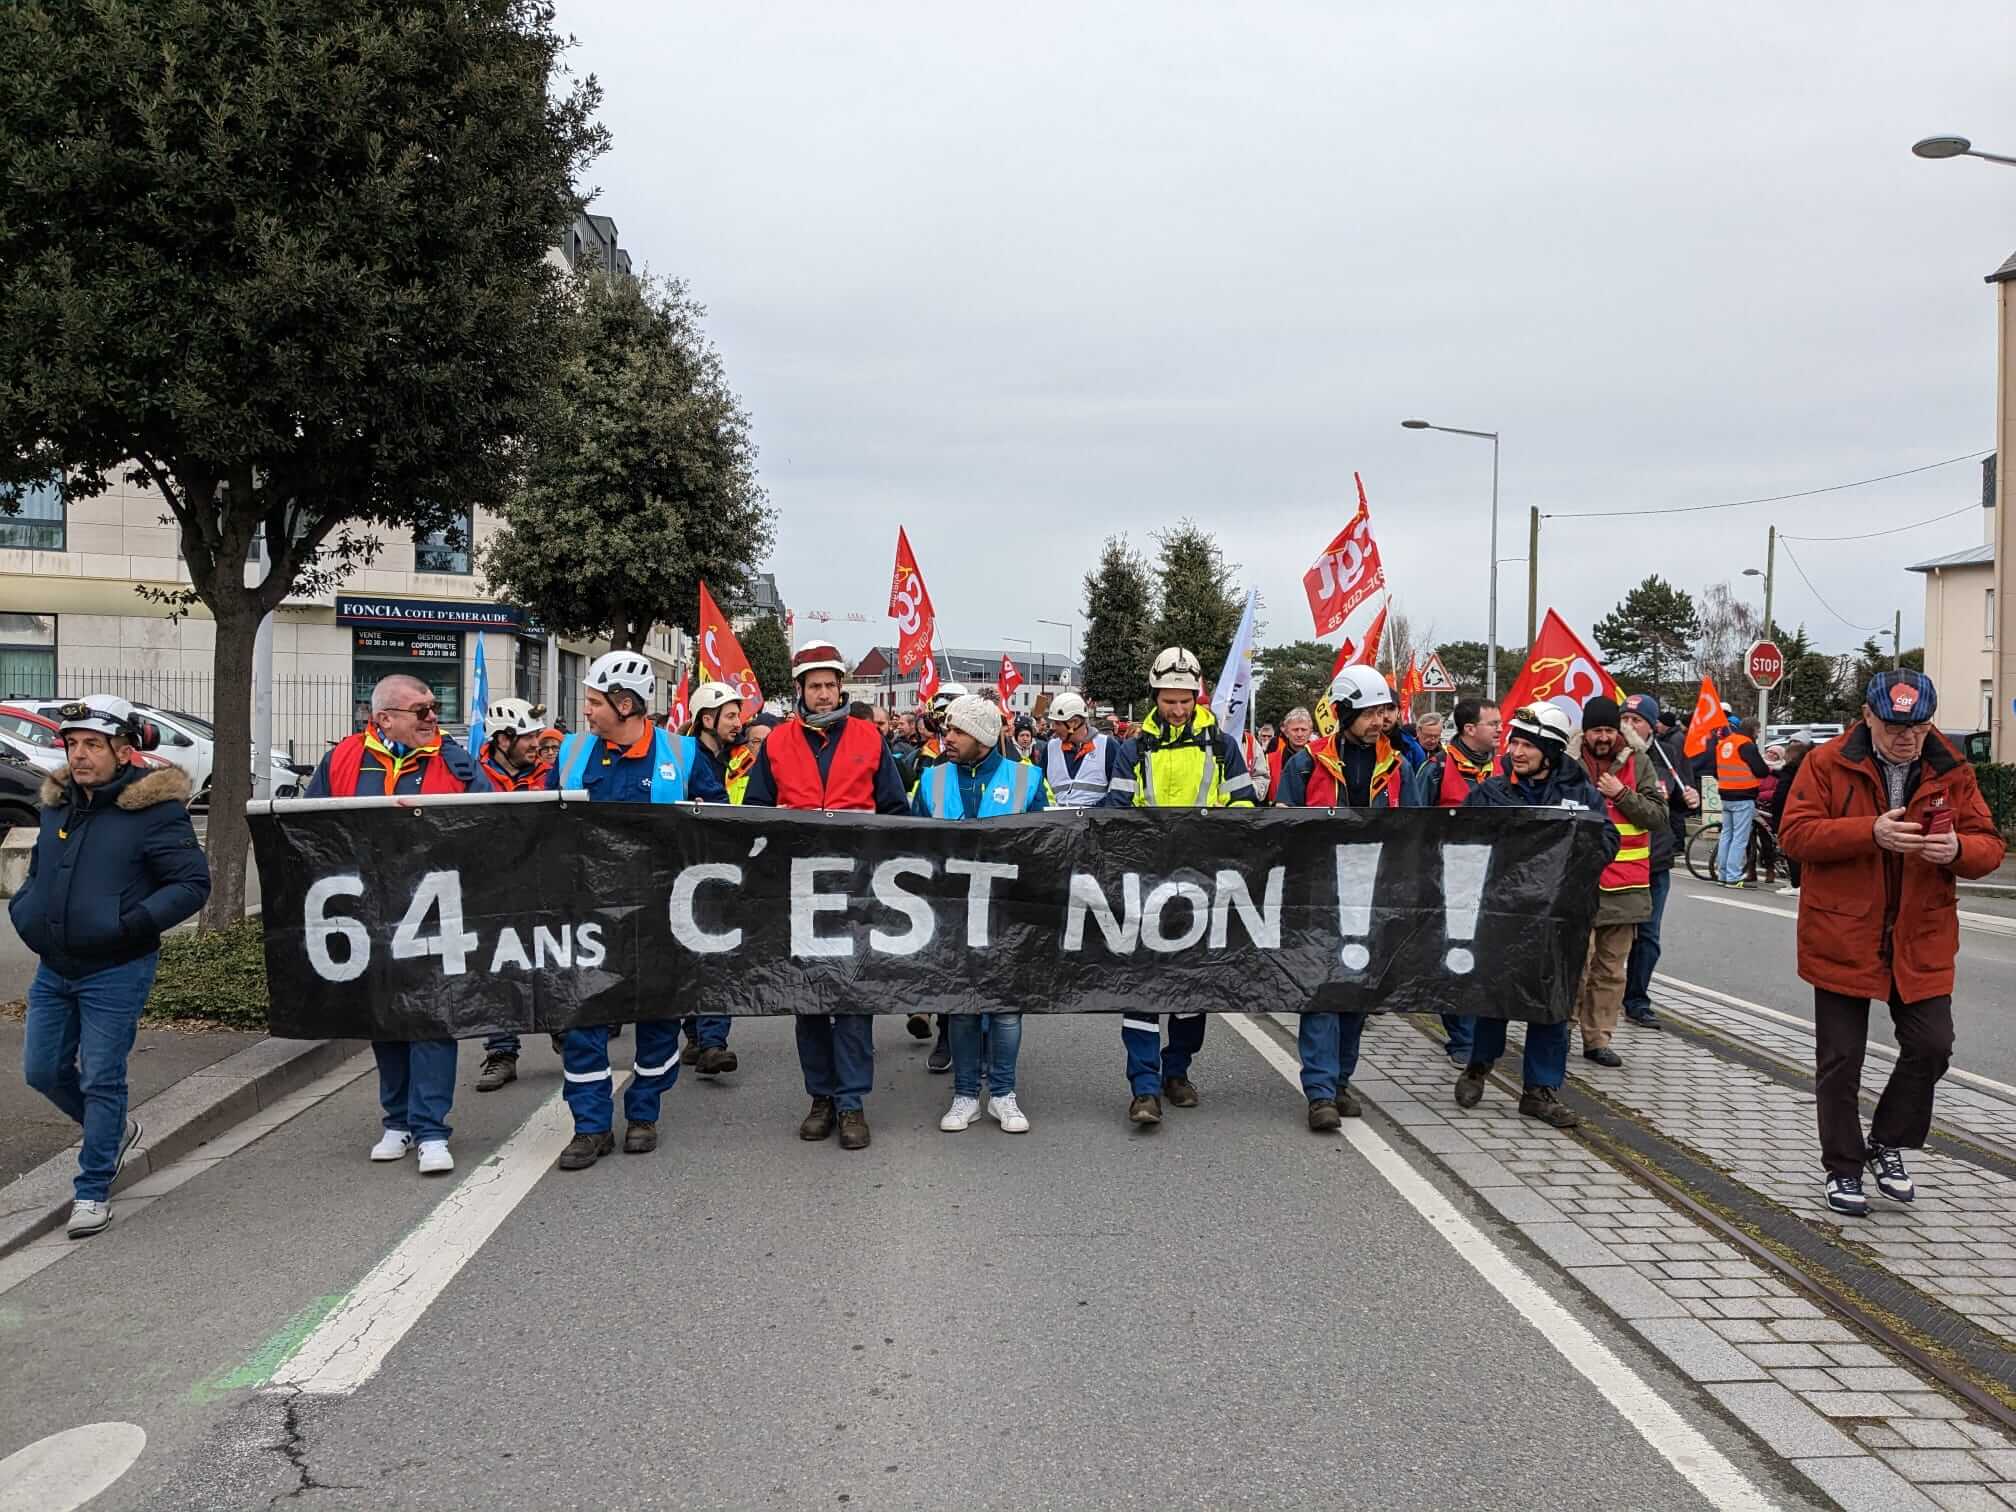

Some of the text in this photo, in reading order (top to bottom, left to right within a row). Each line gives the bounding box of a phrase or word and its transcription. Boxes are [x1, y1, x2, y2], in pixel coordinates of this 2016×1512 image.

[343, 603, 401, 617] FONCIA
[405, 609, 435, 619] COTE
[1752, 657, 1780, 673] STOP
[303, 868, 479, 982] 64
[490, 921, 607, 973] ANS
[668, 835, 1019, 958] C'EST
[1063, 866, 1286, 954] NON
